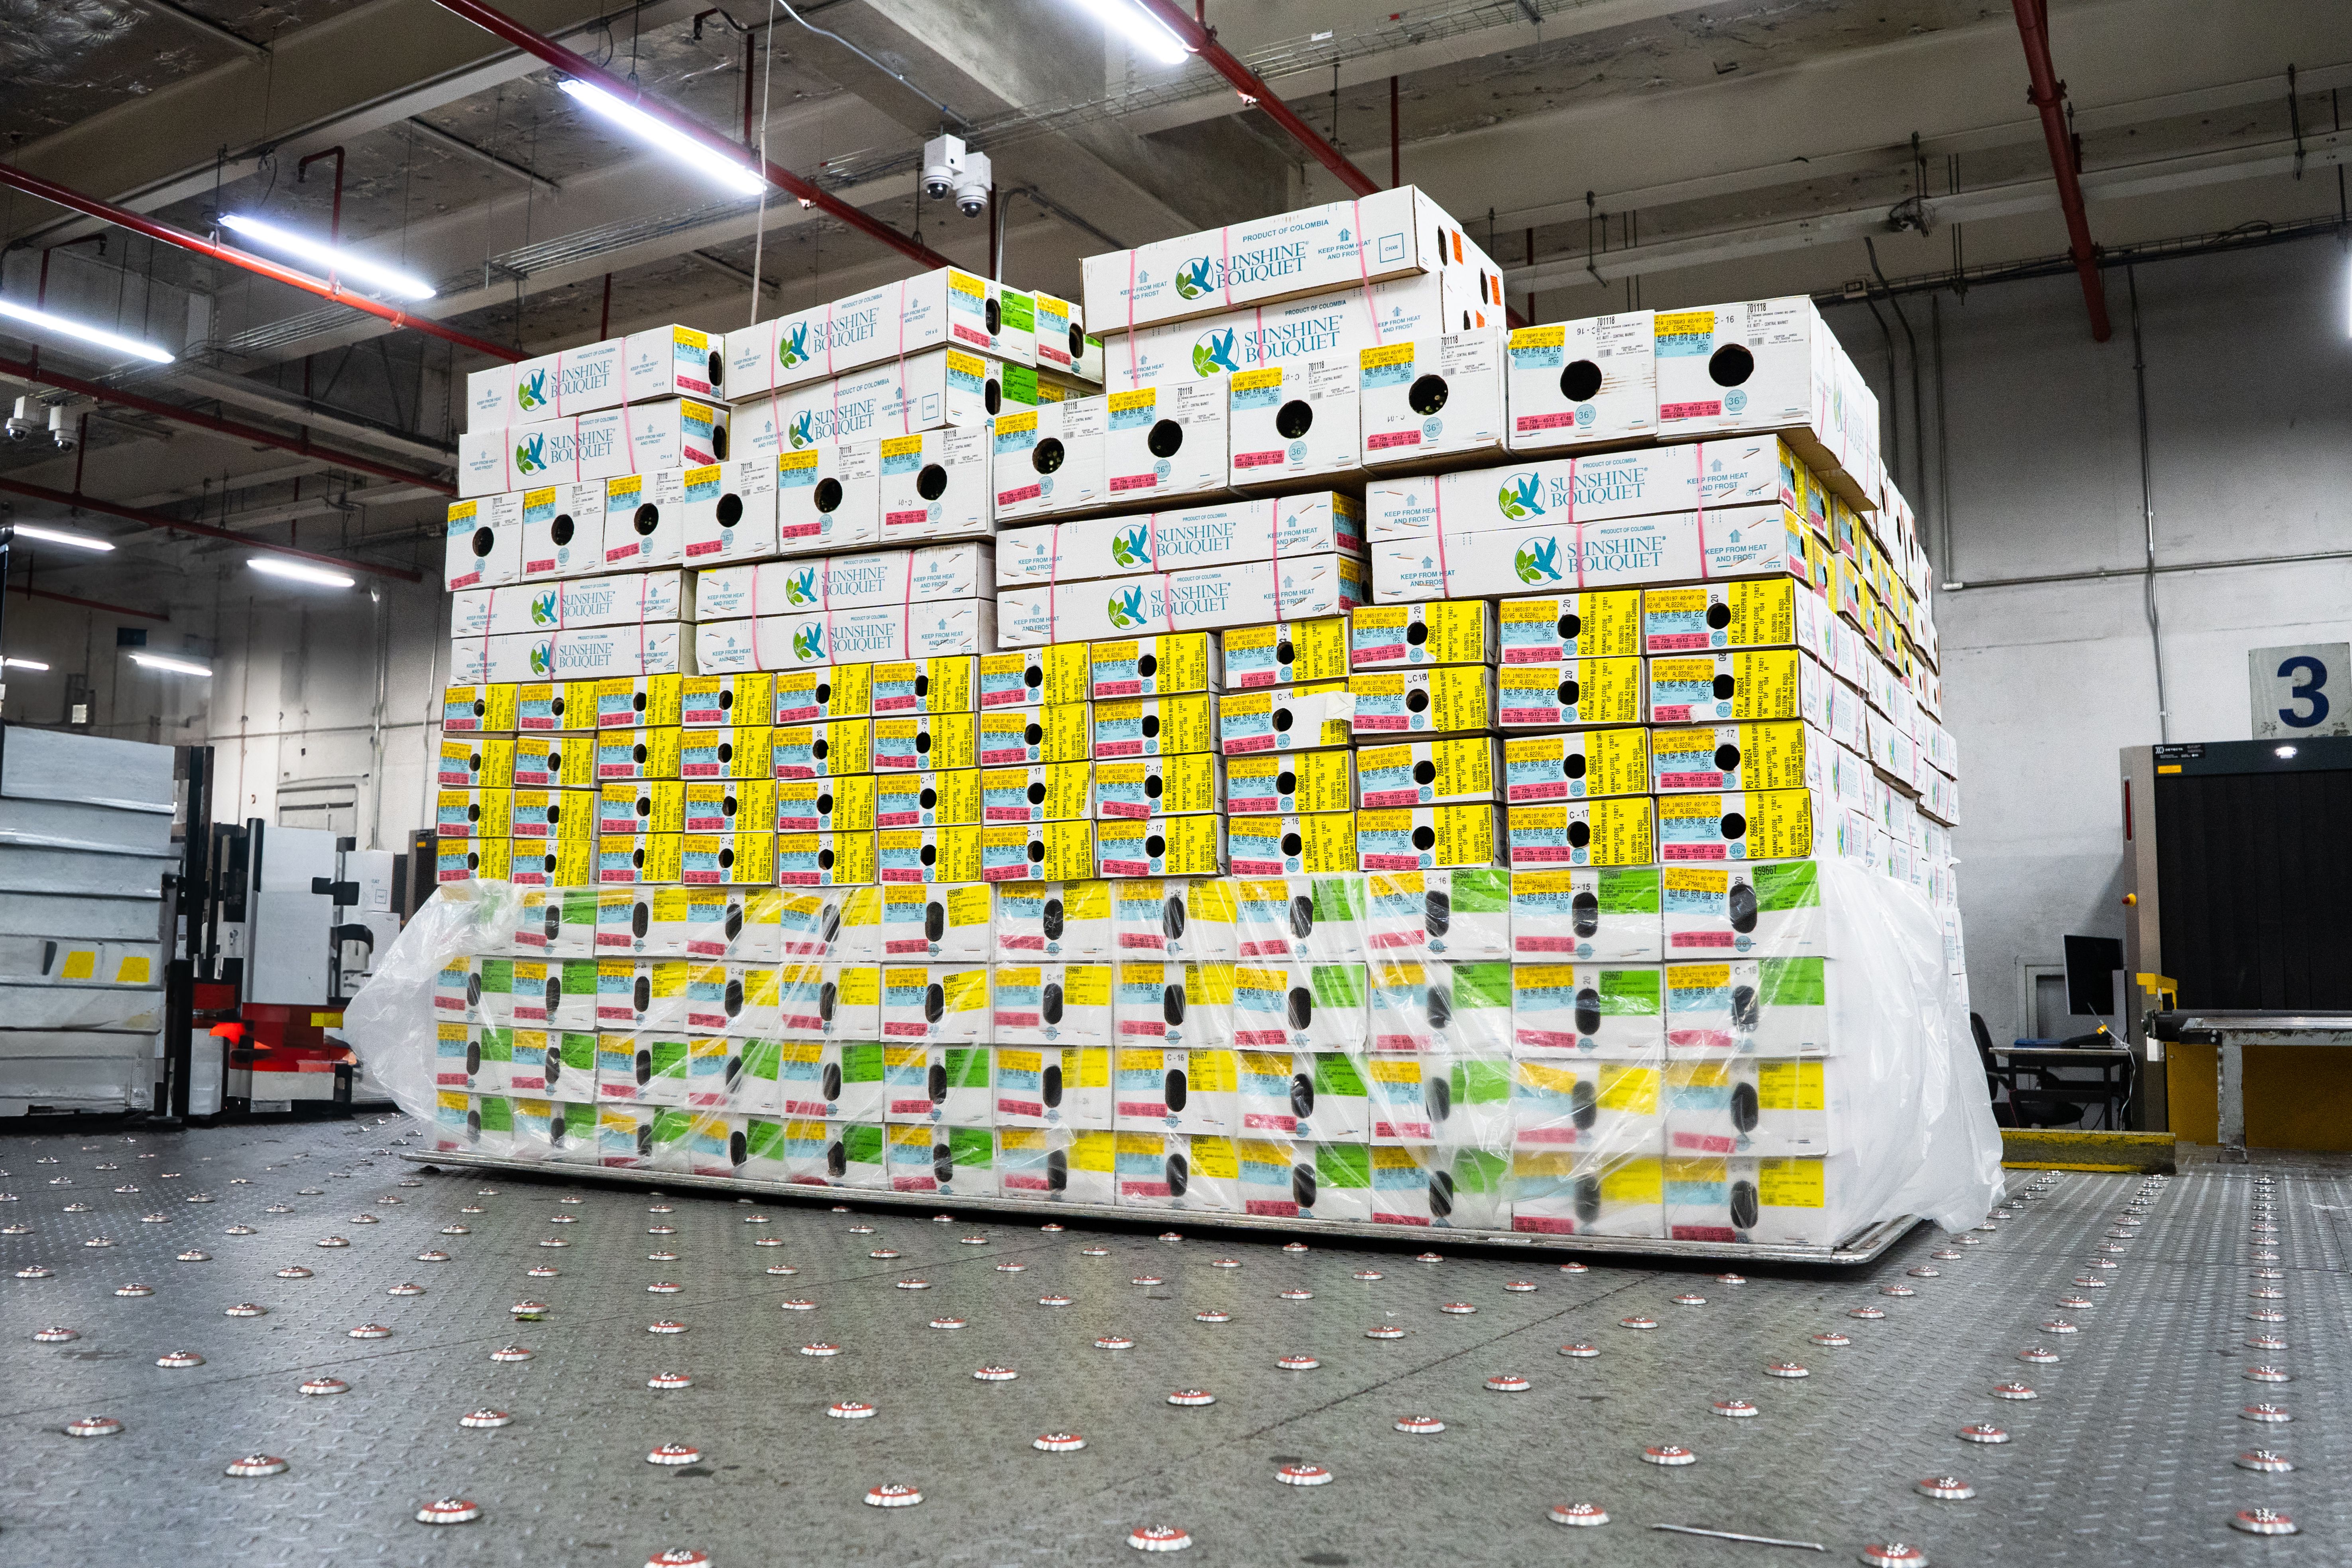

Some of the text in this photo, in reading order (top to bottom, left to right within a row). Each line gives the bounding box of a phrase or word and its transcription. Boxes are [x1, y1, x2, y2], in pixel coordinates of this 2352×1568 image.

[1243, 230, 1276, 242] PRODUCT
[1290, 219, 1329, 232] COLOMBIA
[1356, 239, 1371, 248] HEAT
[1216, 242, 1306, 273] SUNSHINE
[1217, 257, 1306, 288] BOUQUET
[842, 301, 858, 309] PRODUCT
[864, 293, 883, 303] COLOMBIA
[1285, 306, 1310, 316] PRODUCT
[1319, 299, 1346, 309] COLOMBIA
[1747, 303, 1766, 313] 701118
[814, 308, 877, 338] SUNSHINE
[1597, 316, 1615, 326] 701118
[814, 323, 876, 353] BOUQUET
[1245, 316, 1339, 347] SUNSHINE
[1441, 336, 1458, 345] 701118
[1246, 331, 1339, 362] BOUQUET
[551, 361, 610, 384] SUNSHINE
[551, 377, 610, 398] BOUQUET
[814, 400, 874, 425] SUNSHINE
[815, 415, 873, 440] BOUQUET
[551, 429, 612, 449] SUNSHINE
[551, 443, 613, 463] BOUQUET
[741, 462, 752, 471] 701118
[1550, 468, 1644, 492] SUNSHINE
[1552, 483, 1645, 507] BOUQUET
[1156, 523, 1233, 541] SUNSHINE
[1156, 537, 1233, 556] BOUQUET
[1567, 536, 1662, 557] SUNSHINE
[1569, 551, 1662, 573] BOUQUET
[822, 568, 885, 585] SUNSHINE
[822, 579, 885, 596] BOUQUET
[1151, 583, 1228, 600] SUNSHINE
[561, 591, 612, 606] SUNSHINE
[1152, 598, 1228, 617] BOUQUET
[562, 602, 612, 617] BOUQUET
[830, 624, 893, 639] SUNSHINE
[559, 643, 612, 655] SUNSHINE
[831, 636, 894, 652] BOUQUET
[559, 655, 612, 668] BOUQUET
[2277, 656, 2329, 727] 3
[1754, 865, 1777, 876] 459667
